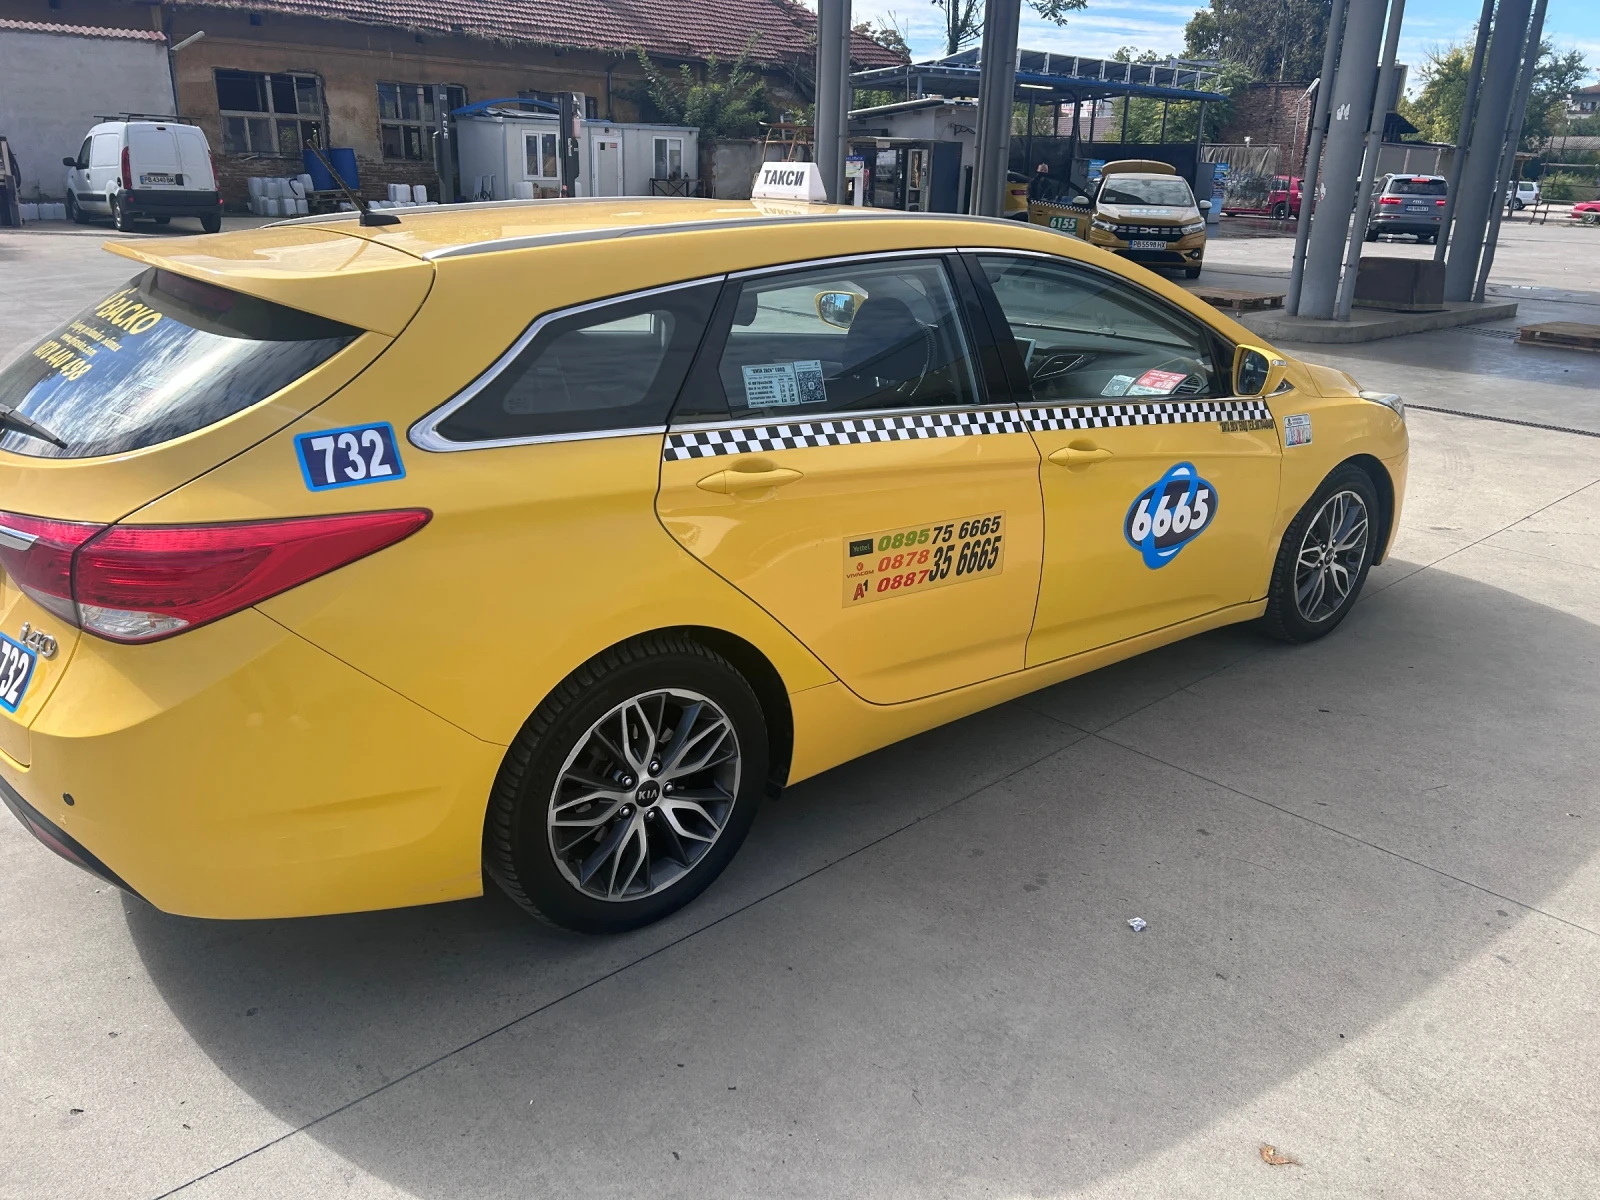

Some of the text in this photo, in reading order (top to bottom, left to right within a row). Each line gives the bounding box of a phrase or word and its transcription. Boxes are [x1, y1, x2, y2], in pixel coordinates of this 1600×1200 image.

[763, 169, 806, 187] ТАКСИ
[1049, 217, 1077, 229] 6155
[60, 357, 93, 382] 498
[311, 429, 393, 483] 732
[877, 528, 931, 552] 0895
[931, 523, 954, 545] 75
[958, 515, 1002, 540] 6665
[1131, 488, 1209, 542] 6665
[846, 535, 1002, 582] VIVACOM 0878 35 6665
[853, 569, 930, 601] A1 0887
[20, 621, 57, 658] i40
[0, 640, 30, 705] 732
[638, 789, 658, 800] KIA
